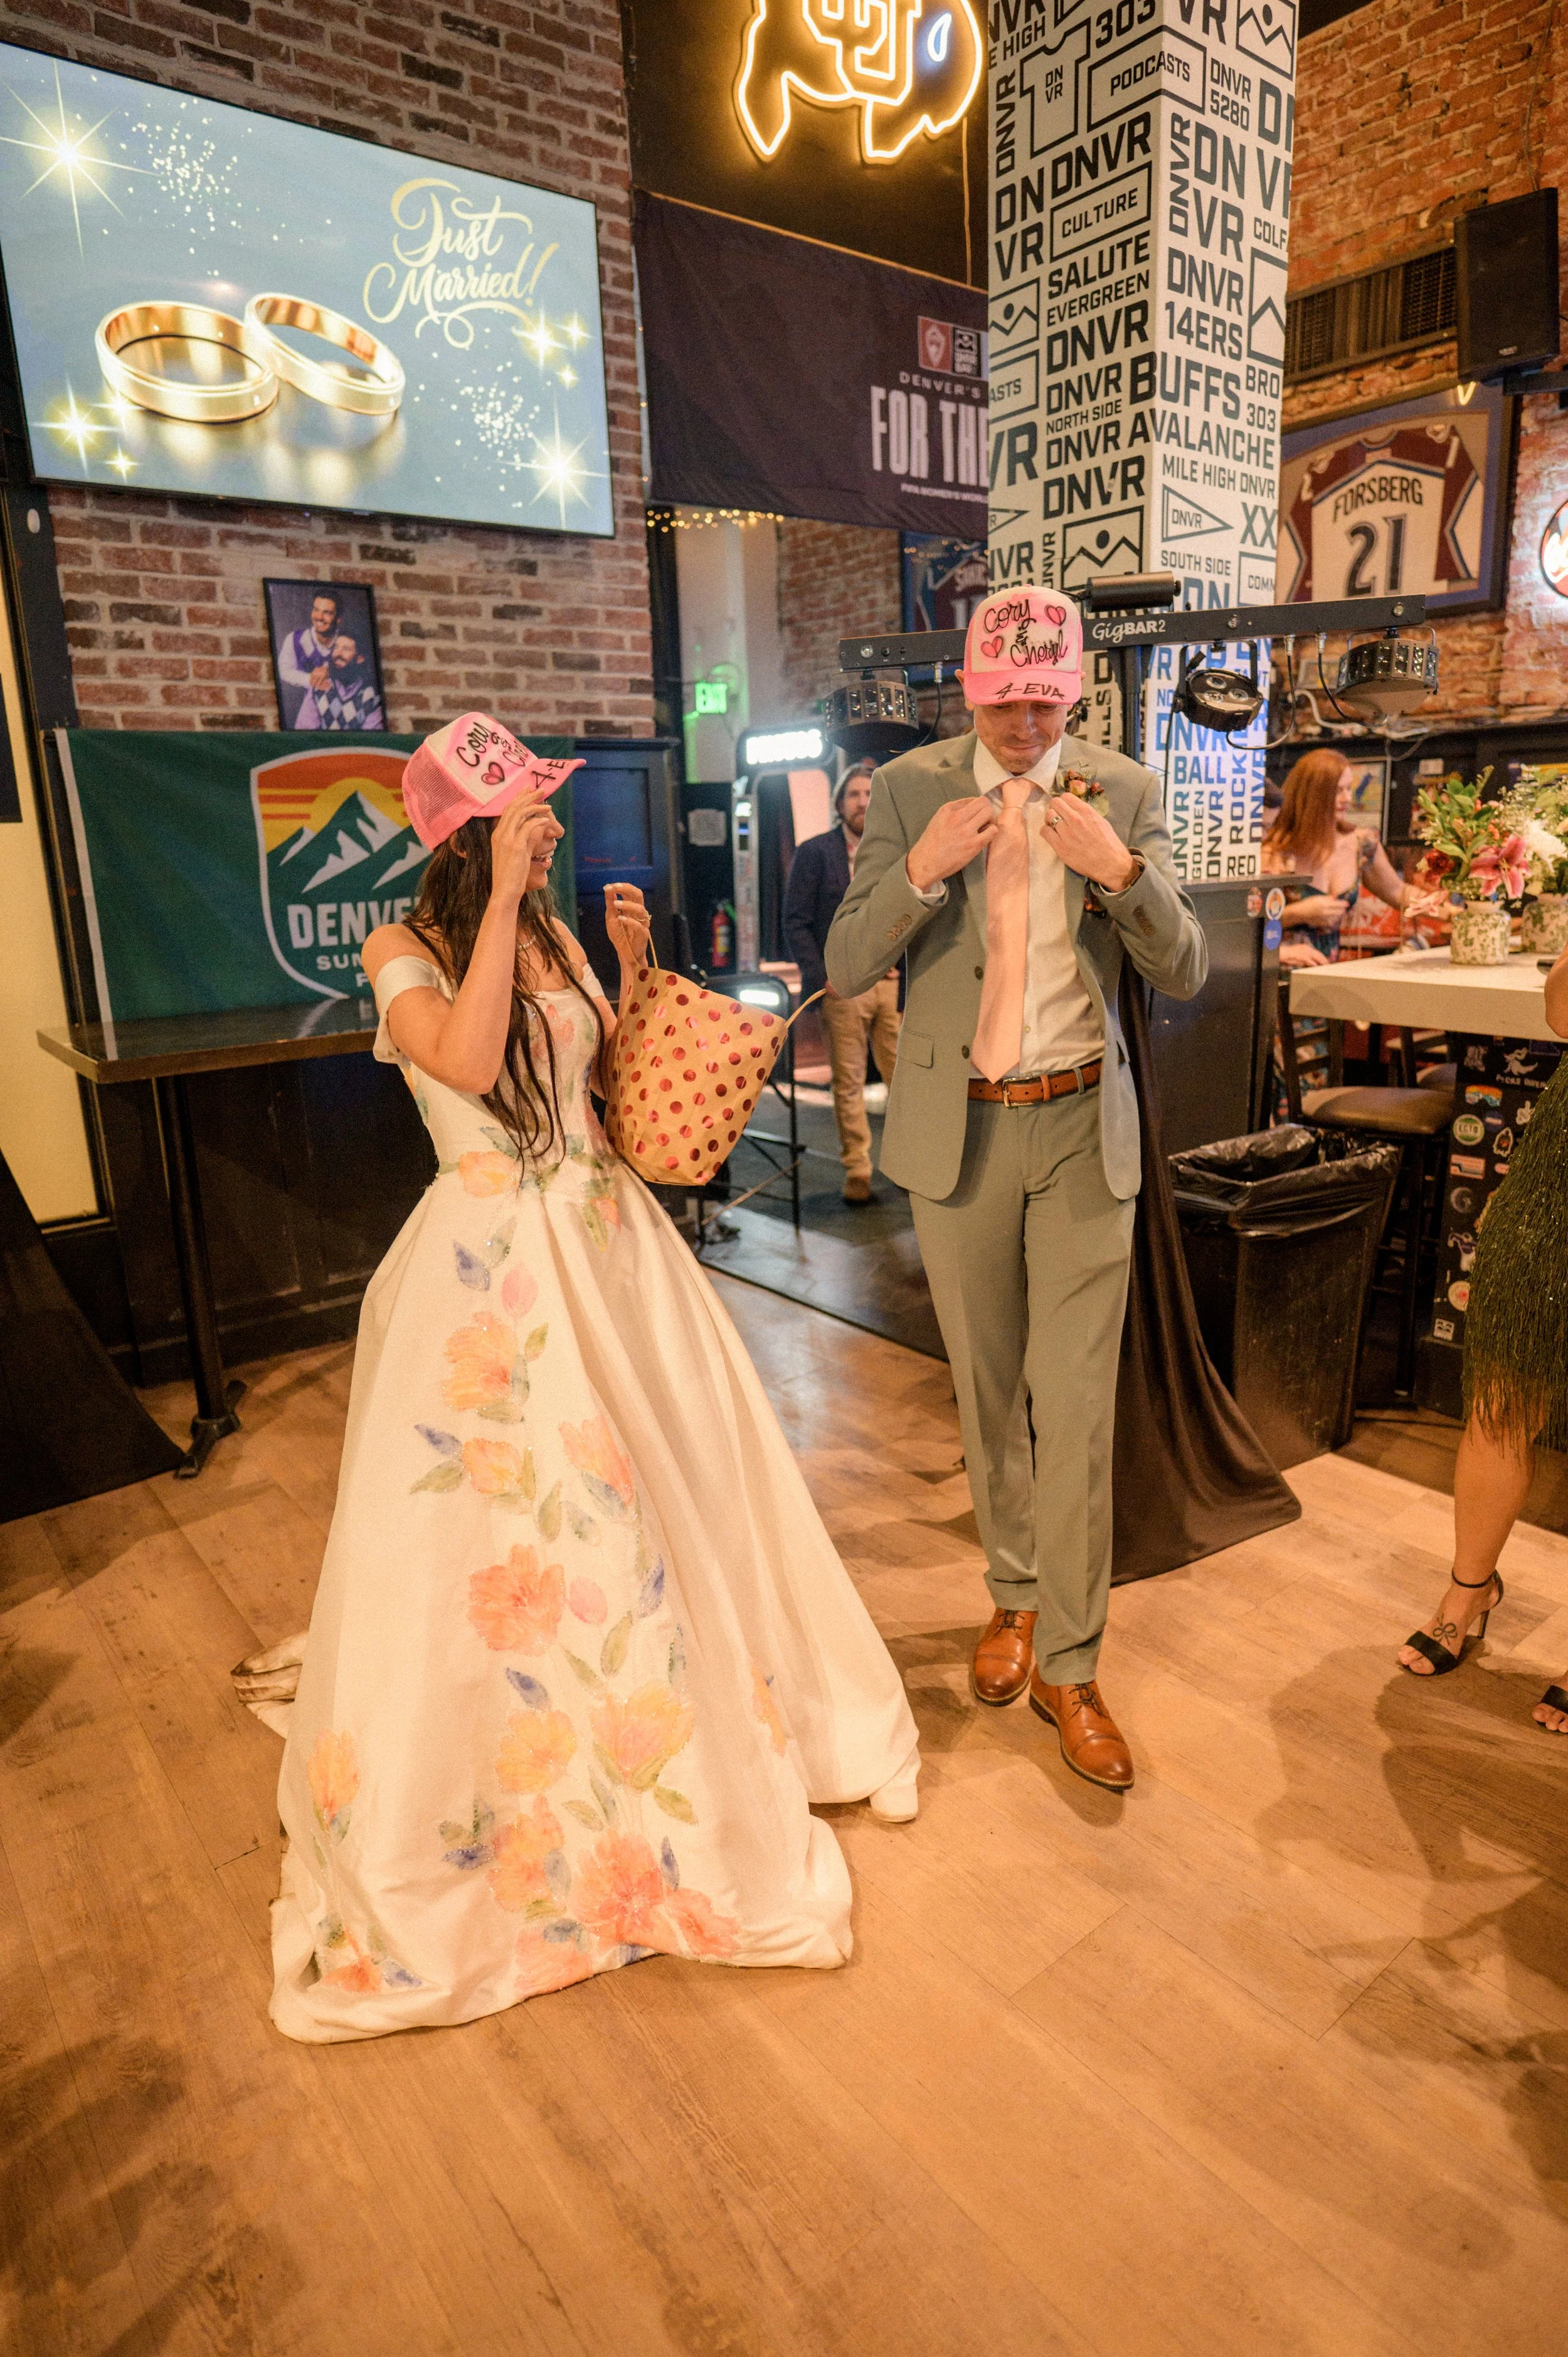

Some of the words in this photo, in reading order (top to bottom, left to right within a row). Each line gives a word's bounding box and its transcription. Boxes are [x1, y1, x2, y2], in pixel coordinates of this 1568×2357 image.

[1003, 14, 1046, 61] HIGH
[1045, 65, 1064, 88] DN
[1045, 82, 1063, 104] VR
[1110, 50, 1191, 97] PODCASTS
[1210, 57, 1252, 102] DNVR
[995, 68, 1016, 179] DNVR
[1209, 90, 1251, 132] 5280
[1051, 110, 1152, 200] DNVR
[1168, 111, 1191, 238] DNVR
[1193, 120, 1246, 200] DN
[390, 177, 532, 269] Just
[995, 167, 1045, 234] DN
[1062, 188, 1139, 239] CULTURE
[1192, 187, 1244, 263] VR
[994, 220, 1044, 282] VR
[1253, 216, 1288, 252] COLF
[1047, 229, 1151, 300] SALUTE
[1167, 245, 1244, 317] DNVR
[363, 242, 559, 349] Married!
[1047, 269, 1150, 327] EVERGREEN
[1046, 299, 1149, 376] DNVR
[1165, 301, 1242, 362] 14ERS
[899, 371, 982, 400] DENVER'S
[1046, 361, 1123, 416] DNVR
[1129, 350, 1241, 421] BUFFS
[870, 385, 930, 480] FOR
[1046, 410, 1089, 437] NORTH
[1091, 398, 1123, 423] SIDE
[1128, 407, 1275, 471] AVALANCHE
[1246, 403, 1278, 434] 303
[1046, 419, 1121, 471] DNVR
[1043, 455, 1145, 521] DNVR
[1162, 453, 1199, 484] MILE
[1202, 464, 1237, 492] HIGH
[1239, 472, 1276, 500] DNVR
[1332, 476, 1424, 523] FORSBERG
[1171, 509, 1203, 530] DNVR
[1160, 550, 1202, 573] SOUTH
[1205, 556, 1231, 577] SIDE
[1345, 513, 1407, 598] 21
[984, 599, 1037, 633] Cory
[1010, 629, 1068, 668] Cheryl
[995, 682, 1065, 700] 4-EVA
[456, 721, 499, 767] Cory
[1174, 756, 1227, 785] BALL
[1172, 790, 1190, 880] DNVR
[1192, 790, 1205, 879] GOLDEN
[1207, 790, 1224, 878] DNVR
[1227, 855, 1256, 877] RED
[287, 896, 421, 949] DENVE
